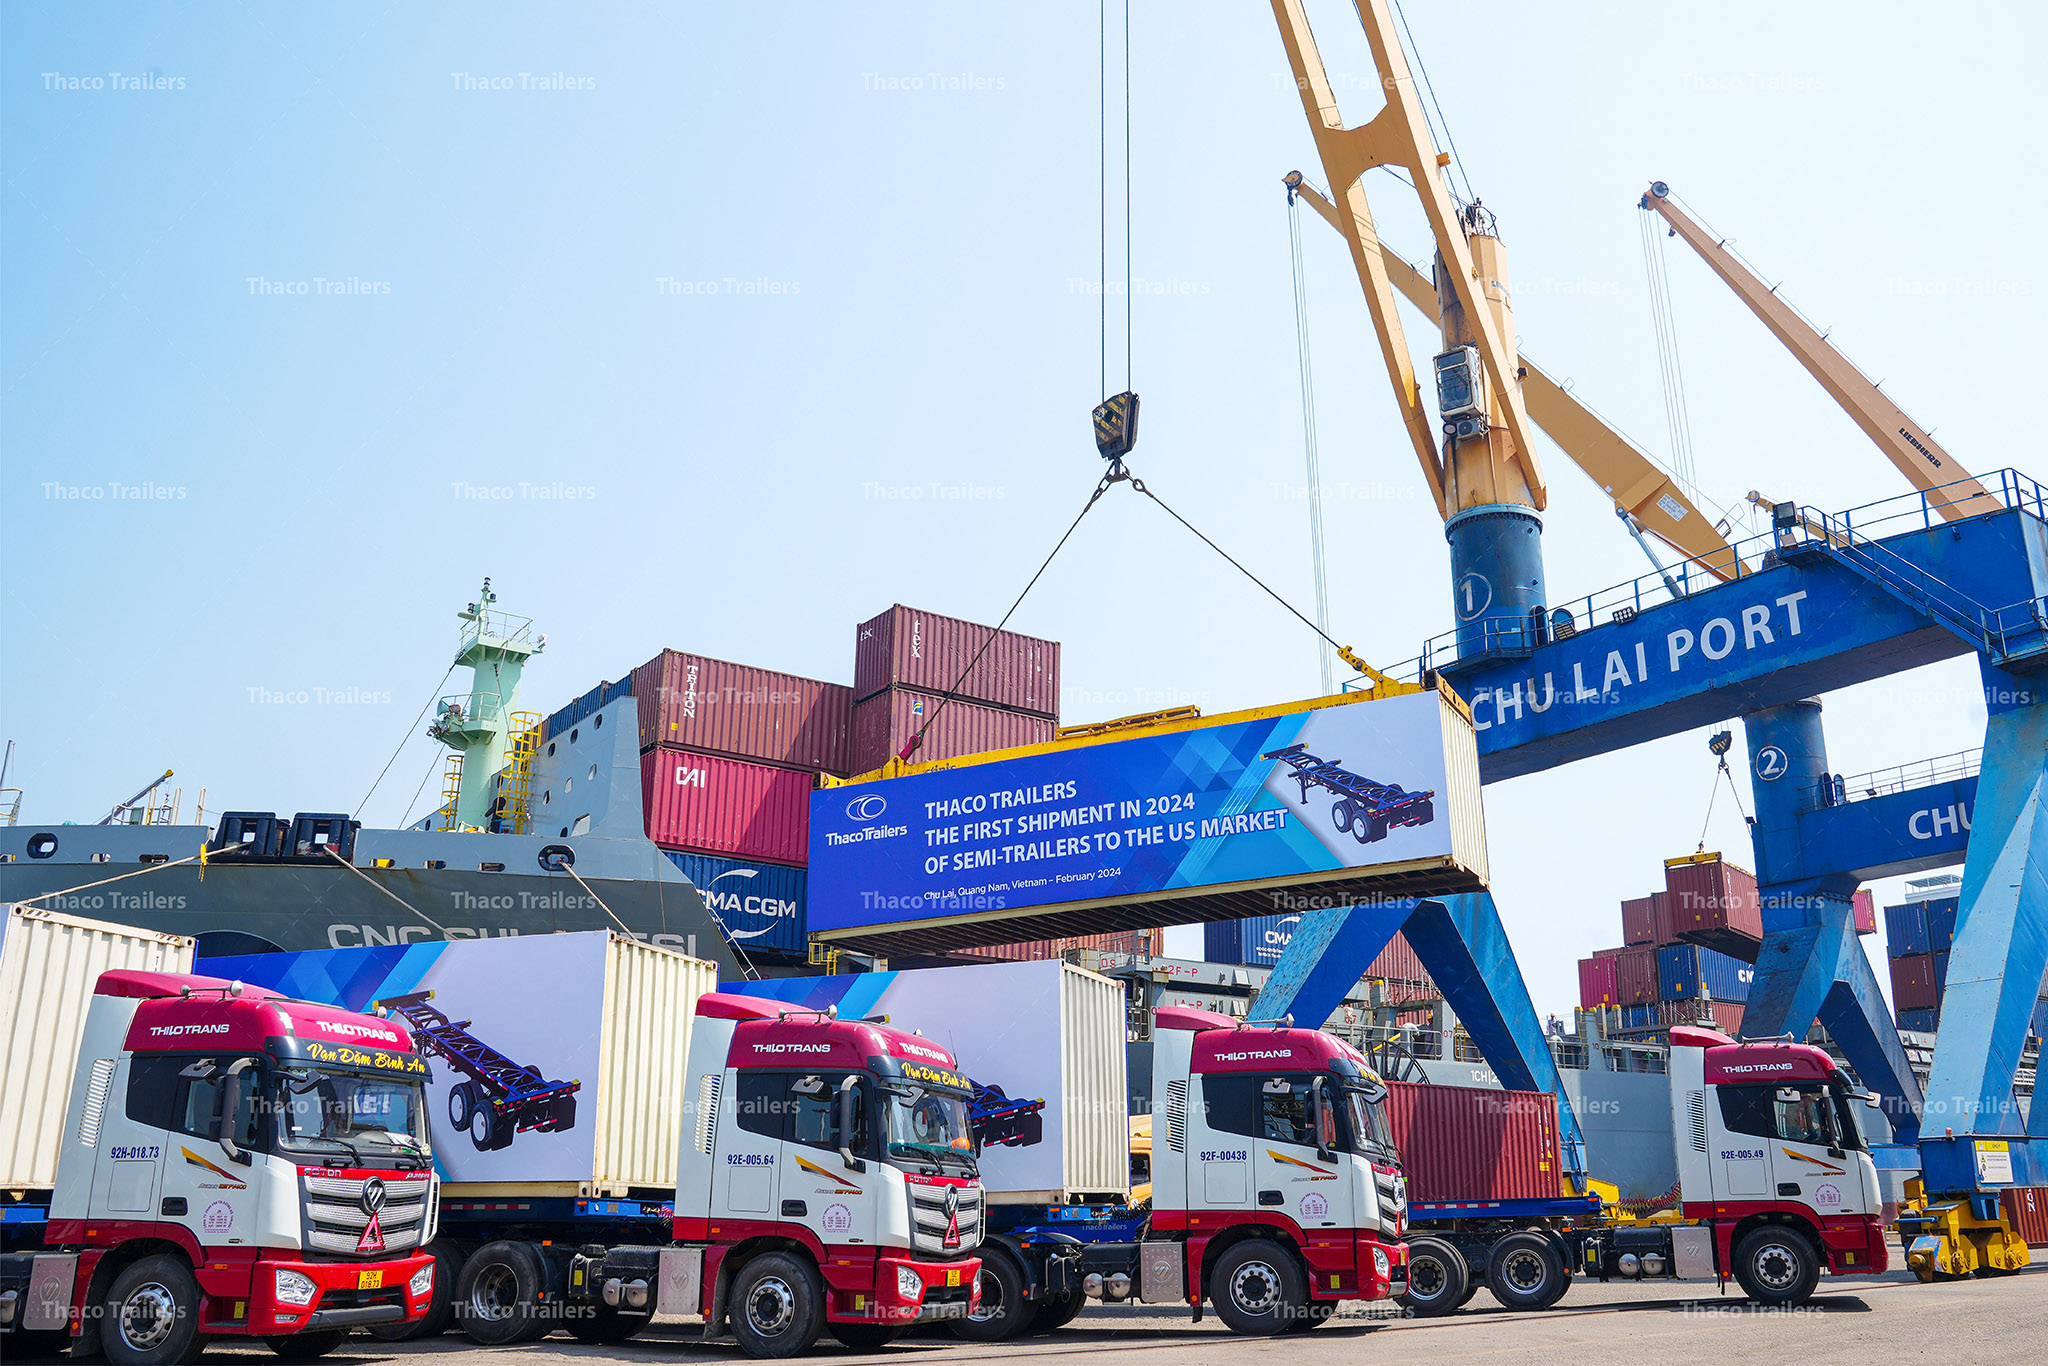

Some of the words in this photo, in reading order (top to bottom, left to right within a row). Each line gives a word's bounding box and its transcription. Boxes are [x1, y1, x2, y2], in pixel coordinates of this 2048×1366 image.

[1898, 427, 1942, 468] LIEBHERR
[1461, 579, 1473, 612] 1
[1470, 671, 1555, 731] CHU
[1573, 642, 1648, 700] LAI
[1666, 589, 1807, 672] PORT
[683, 665, 698, 718] TRITON
[1761, 750, 1781, 775] 2
[676, 766, 706, 788] CAI
[925, 794, 986, 820] THACO
[990, 780, 1077, 809] TRAILERS
[925, 827, 958, 847] THE
[963, 818, 1014, 842] FIRST
[1018, 803, 1115, 835] SHIPMENT
[1120, 799, 1141, 819] IN
[1147, 792, 1196, 817] 2024
[924, 855, 949, 875] OF
[953, 834, 1091, 872] SEMI-TRAILERS
[1094, 831, 1122, 851] TO
[1125, 825, 1164, 848] THE
[1168, 820, 1197, 842] US
[1201, 808, 1289, 839] MARKET
[924, 891, 940, 901] Chu
[942, 888, 957, 899] Lai,
[958, 884, 986, 896] Quang
[988, 881, 1010, 893] Nam,
[1011, 876, 1047, 889] Vietnam
[1056, 870, 1096, 884] February
[1097, 867, 1121, 879] 2024
[744, 895, 796, 918] CGM
[406, 1056, 426, 1074] An
[111, 1146, 160, 1159] 92H-018.73
[727, 1154, 774, 1165] 92E-005.64
[1200, 1150, 1247, 1161] 92F-00438
[1721, 1149, 1764, 1160] 92E-005.49
[304, 1168, 342, 1177] FOTON
[360, 1280, 380, 1289] 018.73
